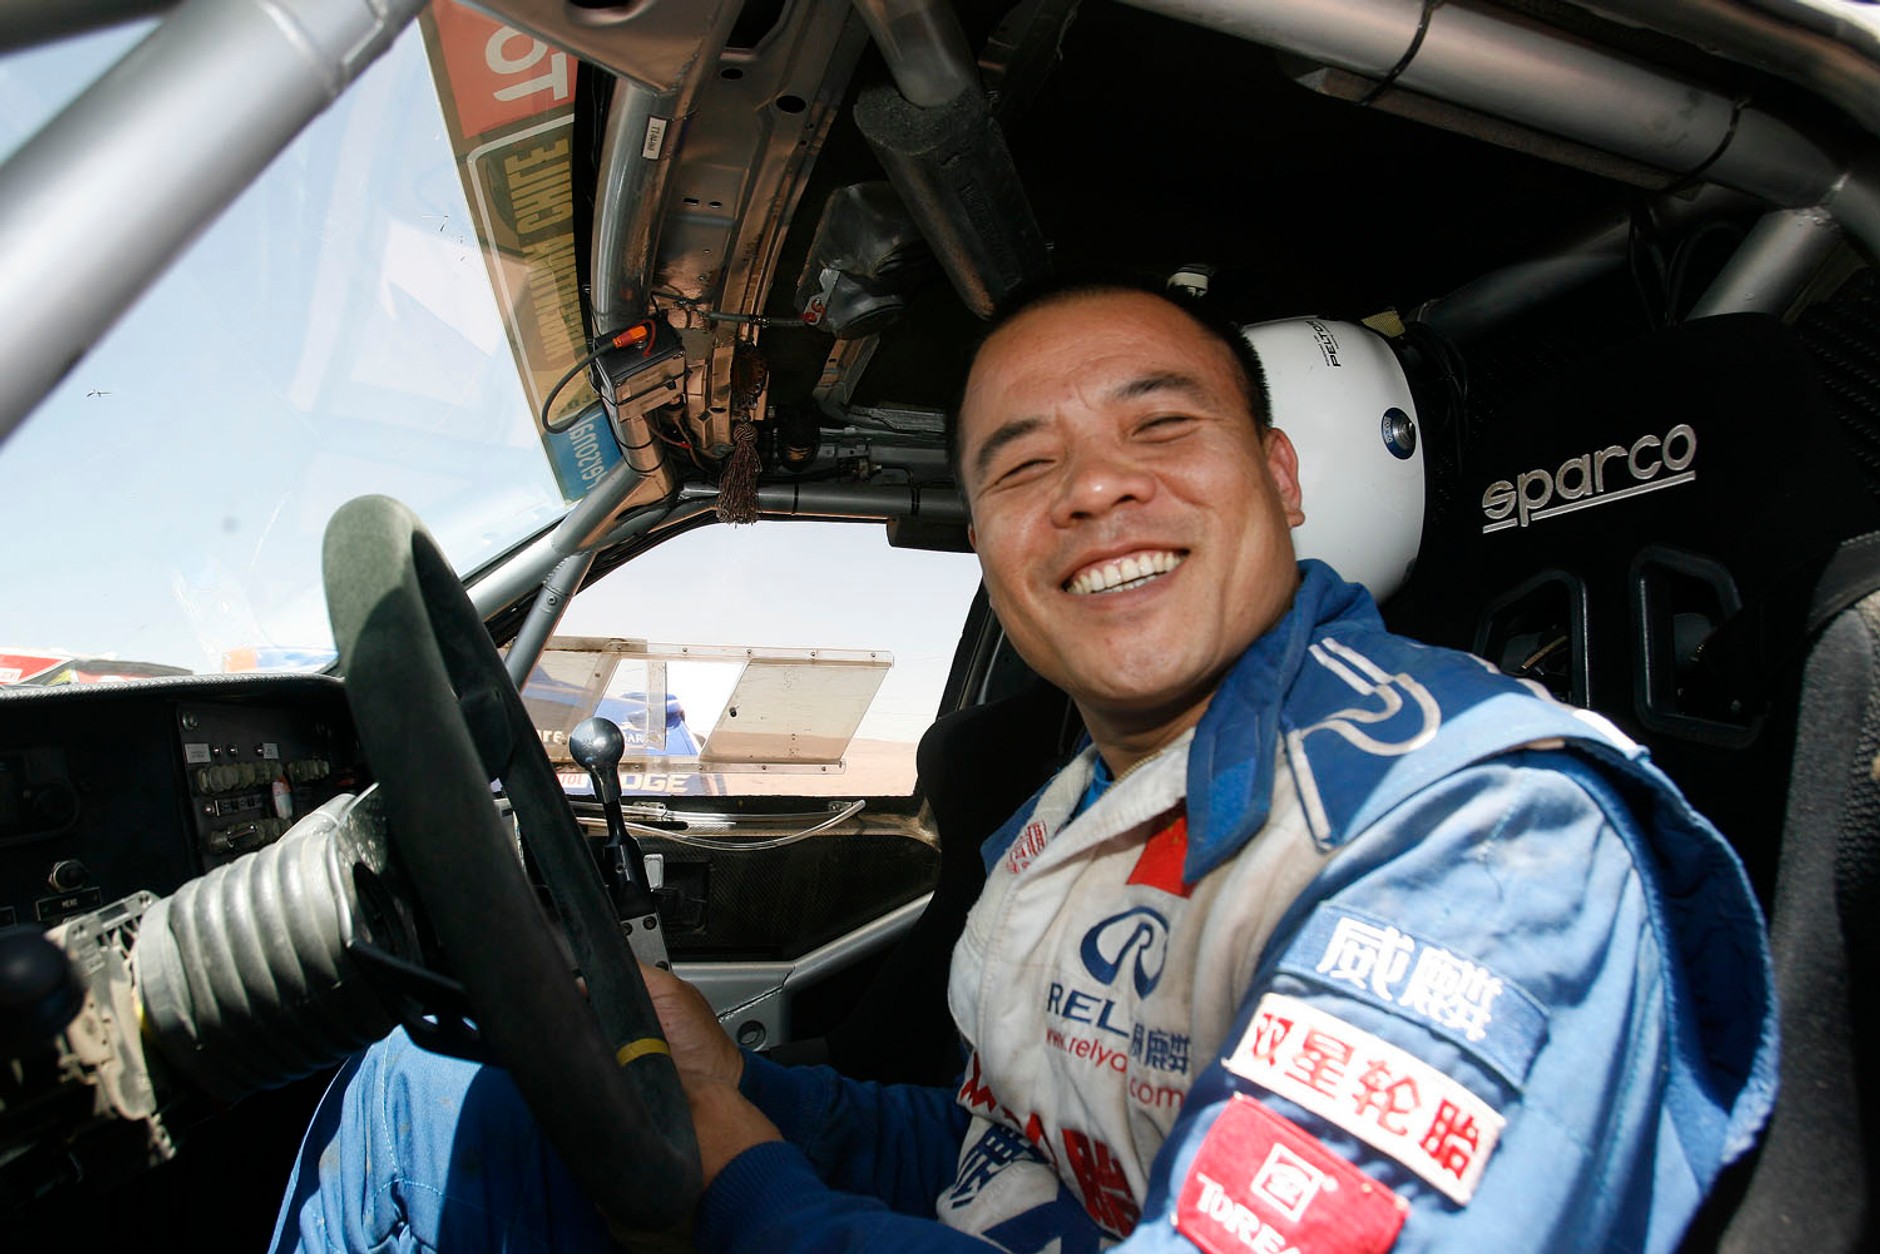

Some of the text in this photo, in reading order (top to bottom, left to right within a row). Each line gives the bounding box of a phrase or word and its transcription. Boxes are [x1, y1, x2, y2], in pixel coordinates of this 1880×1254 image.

[1482, 423, 1698, 528] sparco
[1317, 917, 1504, 1041] 威麟
[1251, 1012, 1480, 1180] 双星轮胎
